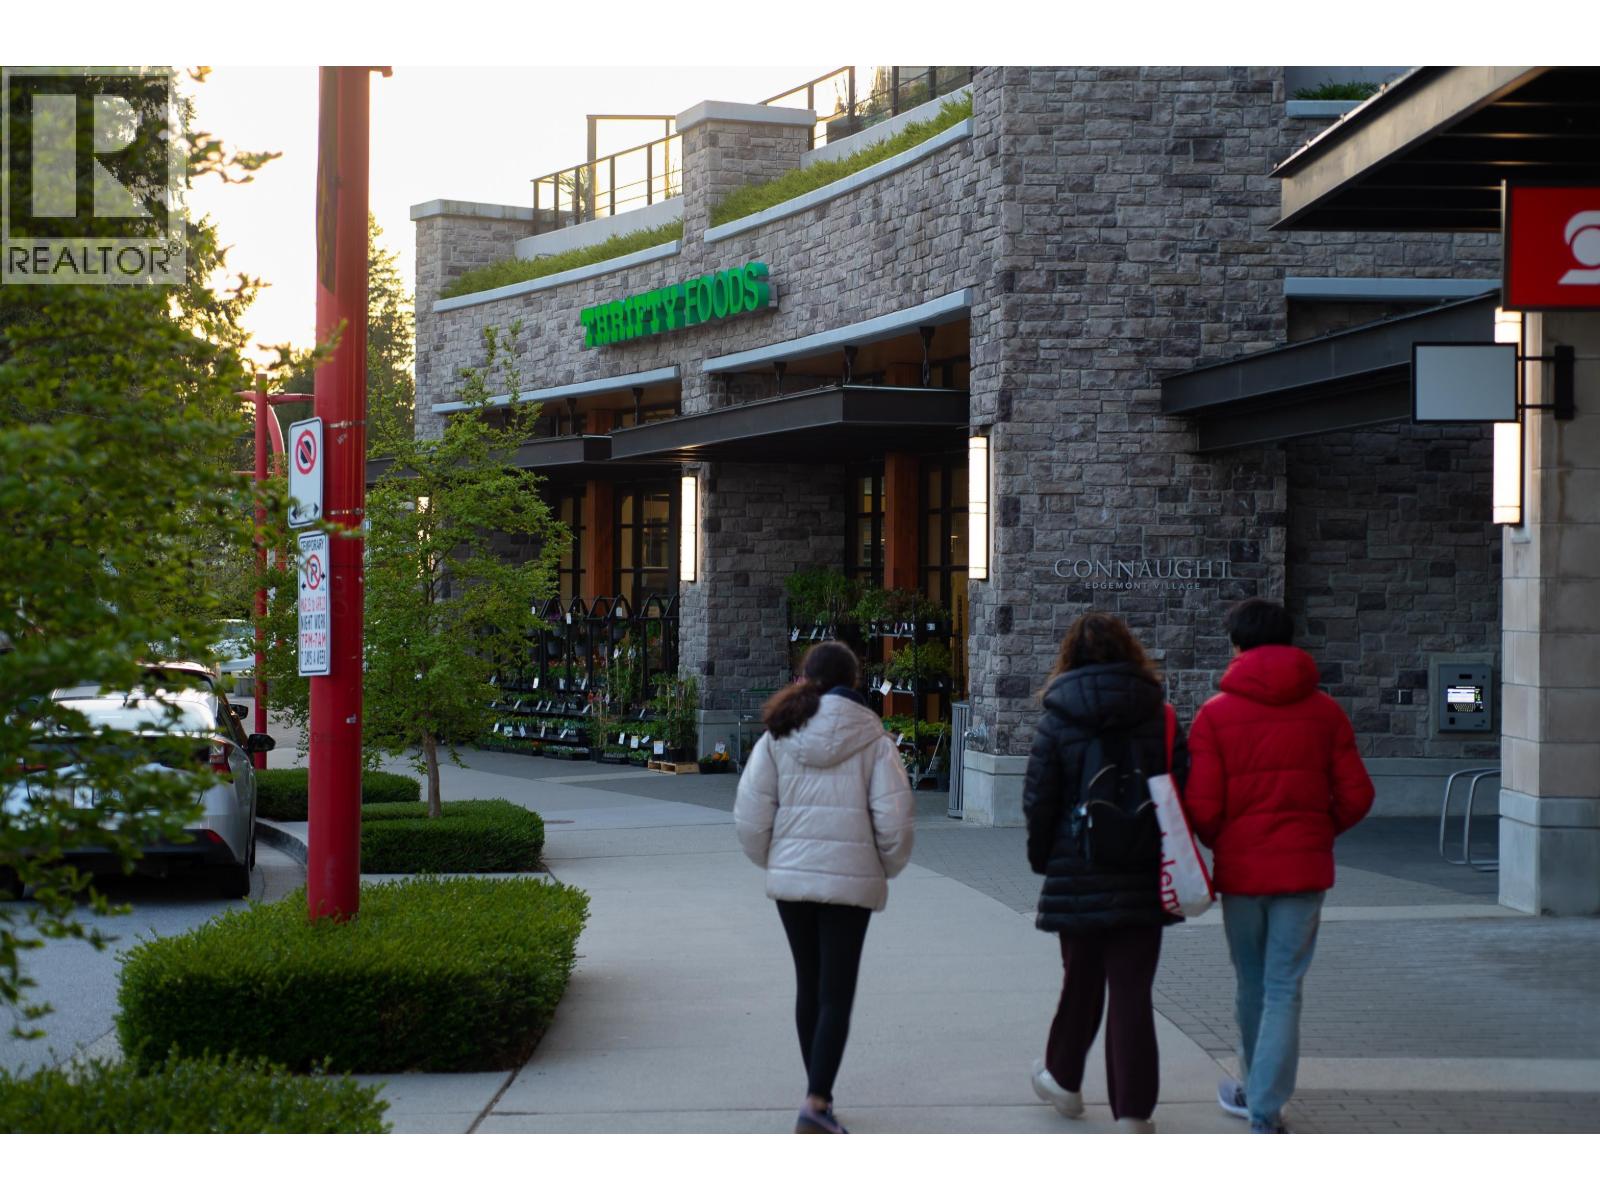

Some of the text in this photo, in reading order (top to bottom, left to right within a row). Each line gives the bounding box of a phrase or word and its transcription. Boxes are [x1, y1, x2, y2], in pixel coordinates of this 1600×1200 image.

[580, 261, 767, 349] THRIFTY FOODS
[1053, 558, 1232, 580] CONNAUGHT
[1085, 582, 1201, 590] EDGEMONT VILLAGE
